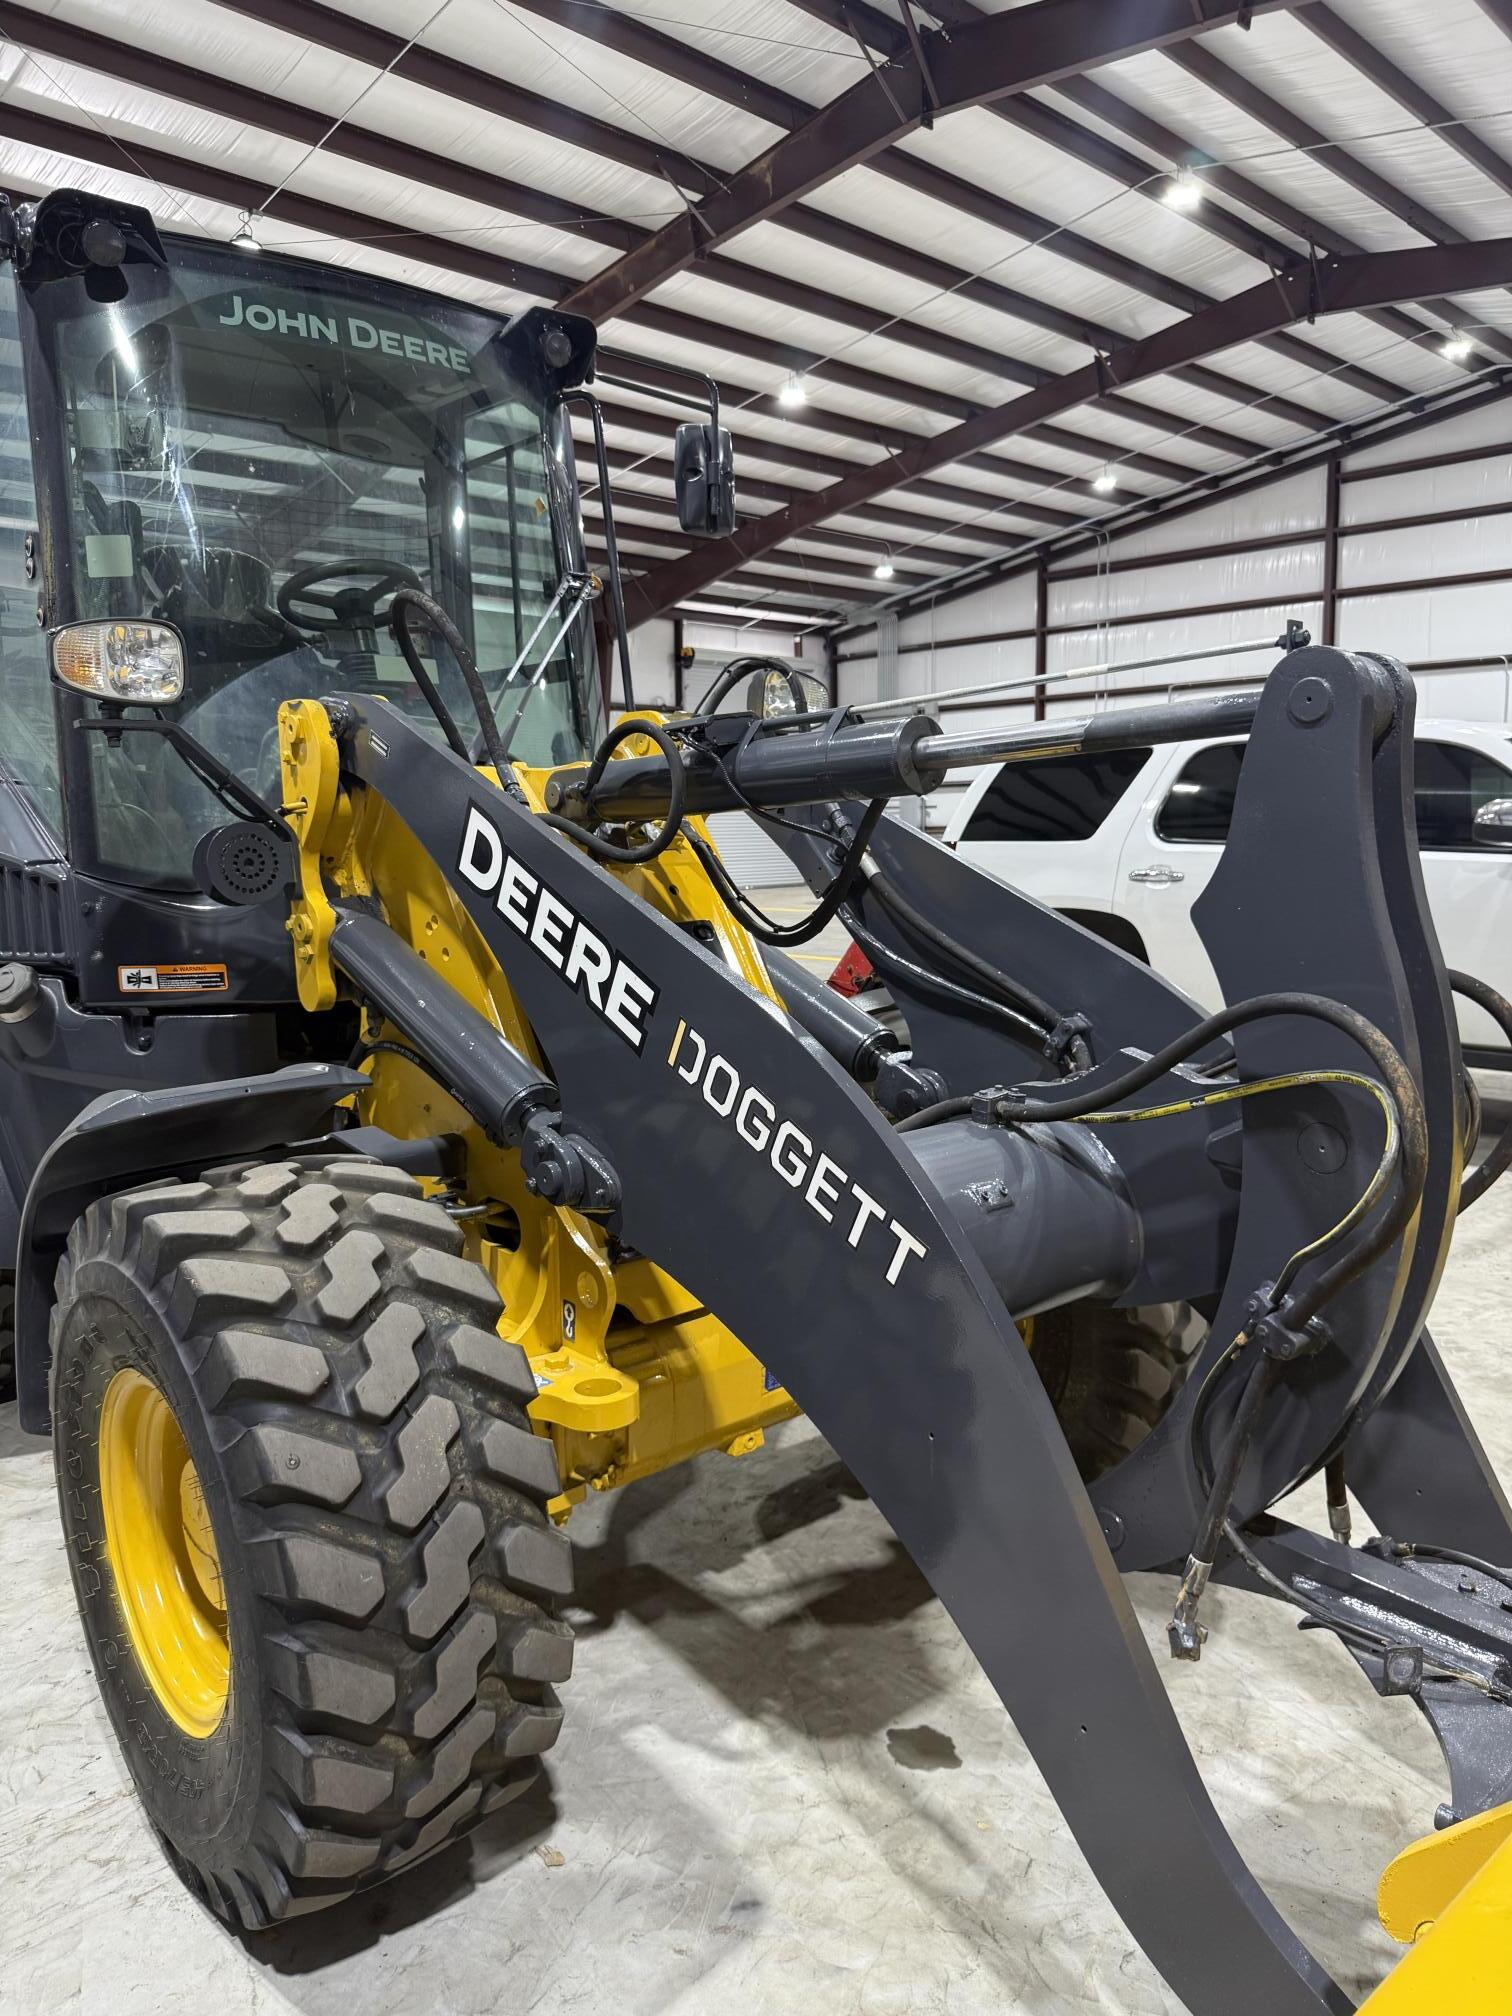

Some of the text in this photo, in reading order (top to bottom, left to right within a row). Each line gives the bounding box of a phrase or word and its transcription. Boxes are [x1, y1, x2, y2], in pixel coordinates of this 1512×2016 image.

[220, 296, 471, 374] JOHN DEERE
[458, 806, 655, 1047] DEERE
[667, 1019, 927, 1286] DOGGETT
